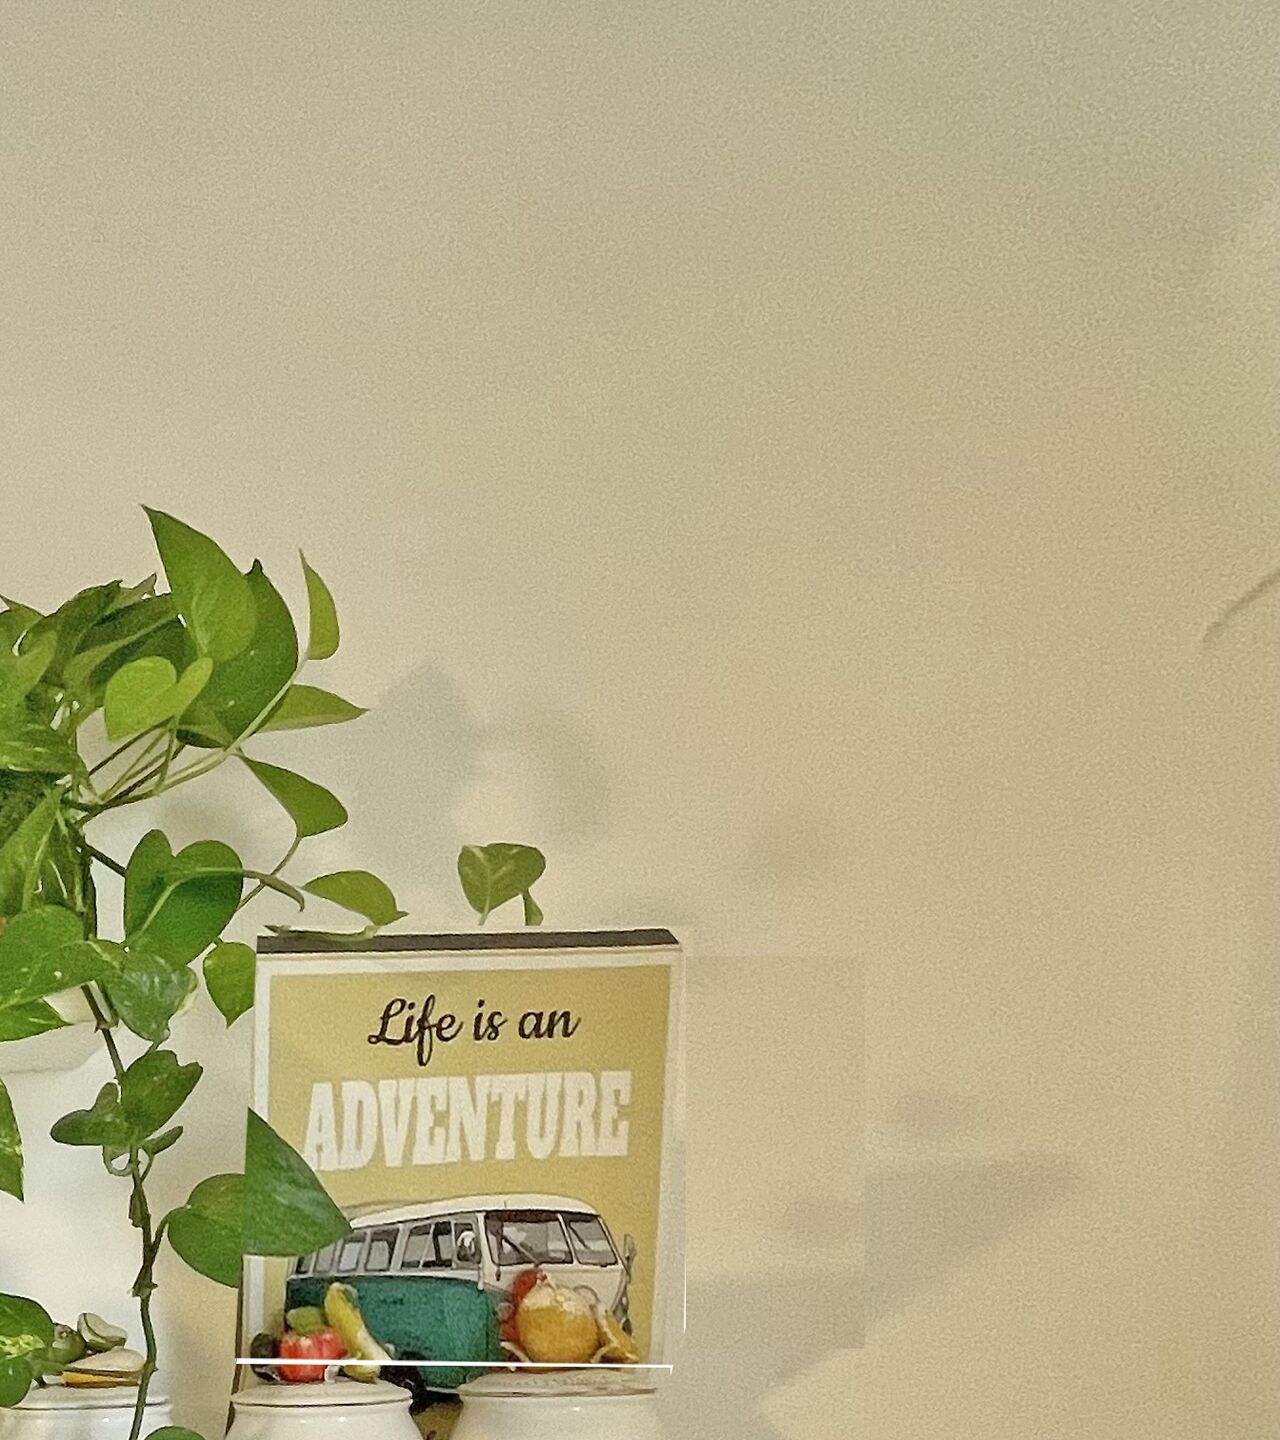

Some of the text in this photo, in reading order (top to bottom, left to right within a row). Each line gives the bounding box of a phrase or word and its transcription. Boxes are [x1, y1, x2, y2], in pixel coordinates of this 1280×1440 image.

[367, 994, 582, 1067] Life is an
[305, 1071, 631, 1171] ADVENTURE
